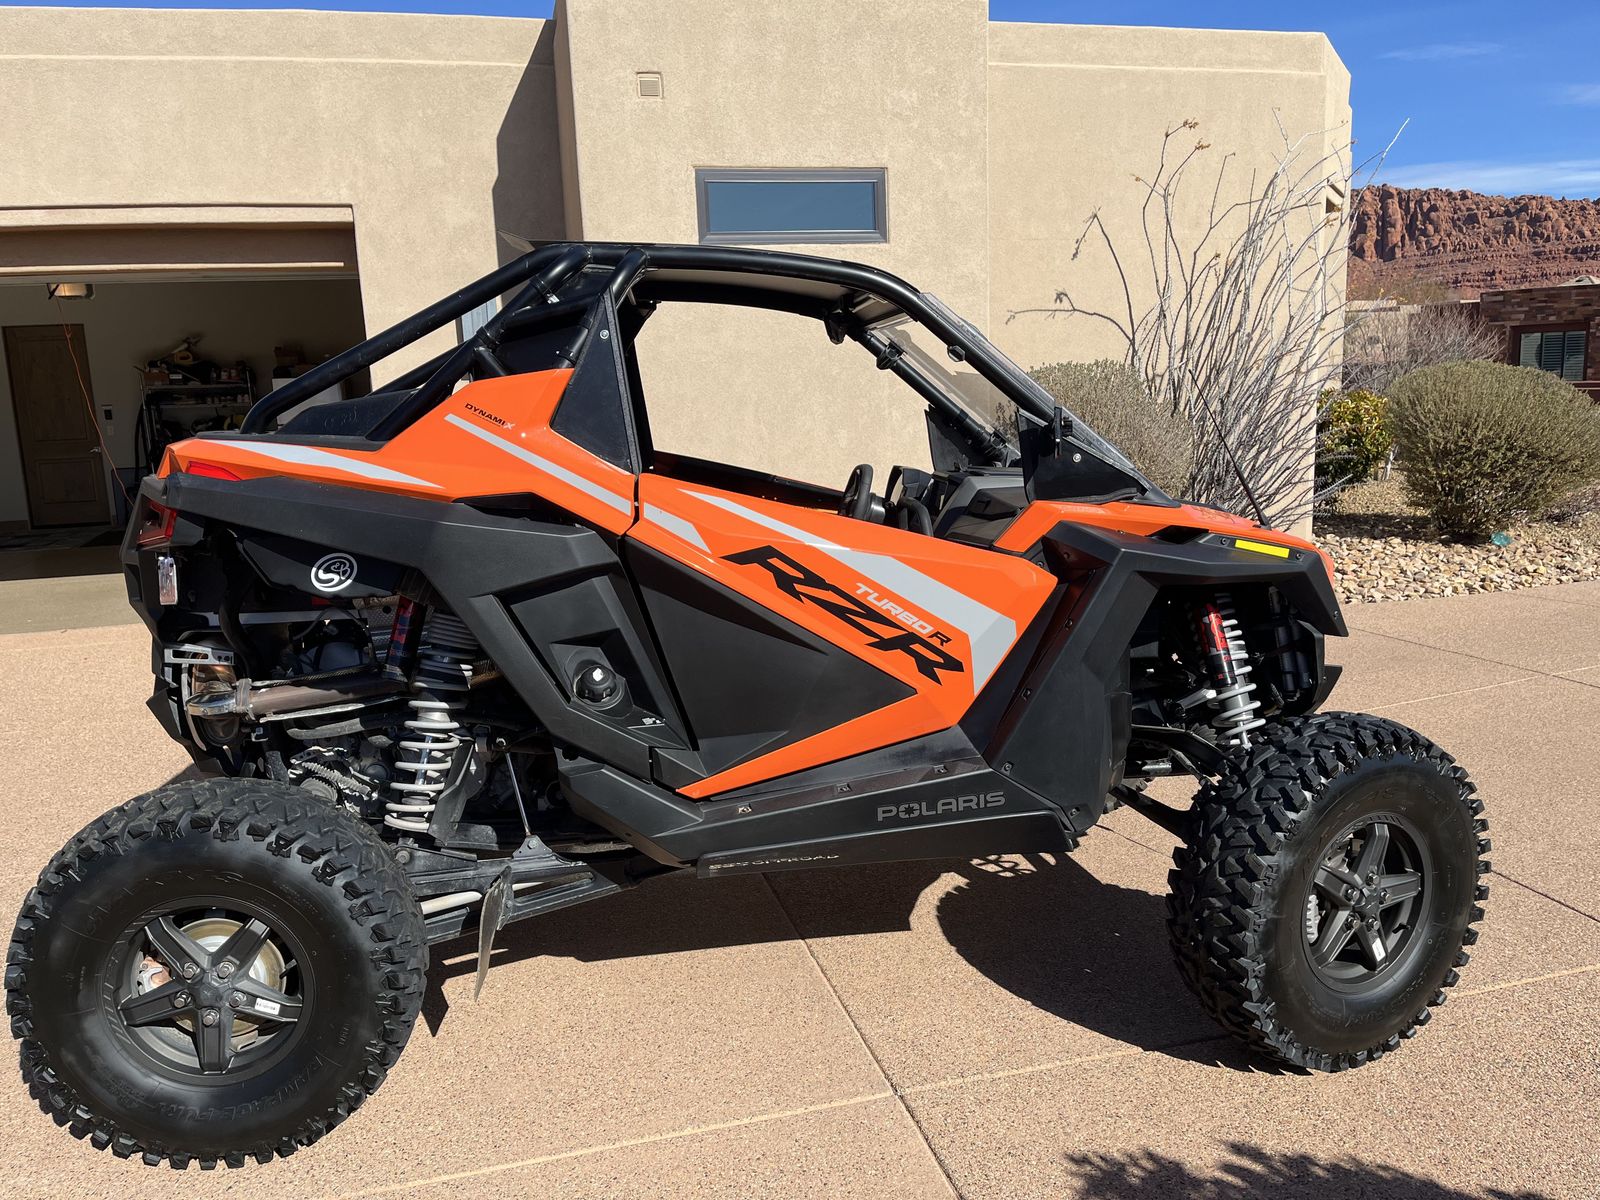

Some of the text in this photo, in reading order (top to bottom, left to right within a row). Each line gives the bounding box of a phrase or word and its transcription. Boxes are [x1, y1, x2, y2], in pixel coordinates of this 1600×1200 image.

[465, 402, 515, 430] DYNAMIX
[719, 544, 965, 686] RZR
[855, 582, 952, 647] TURBO R
[877, 791, 1006, 821] POLARIS
